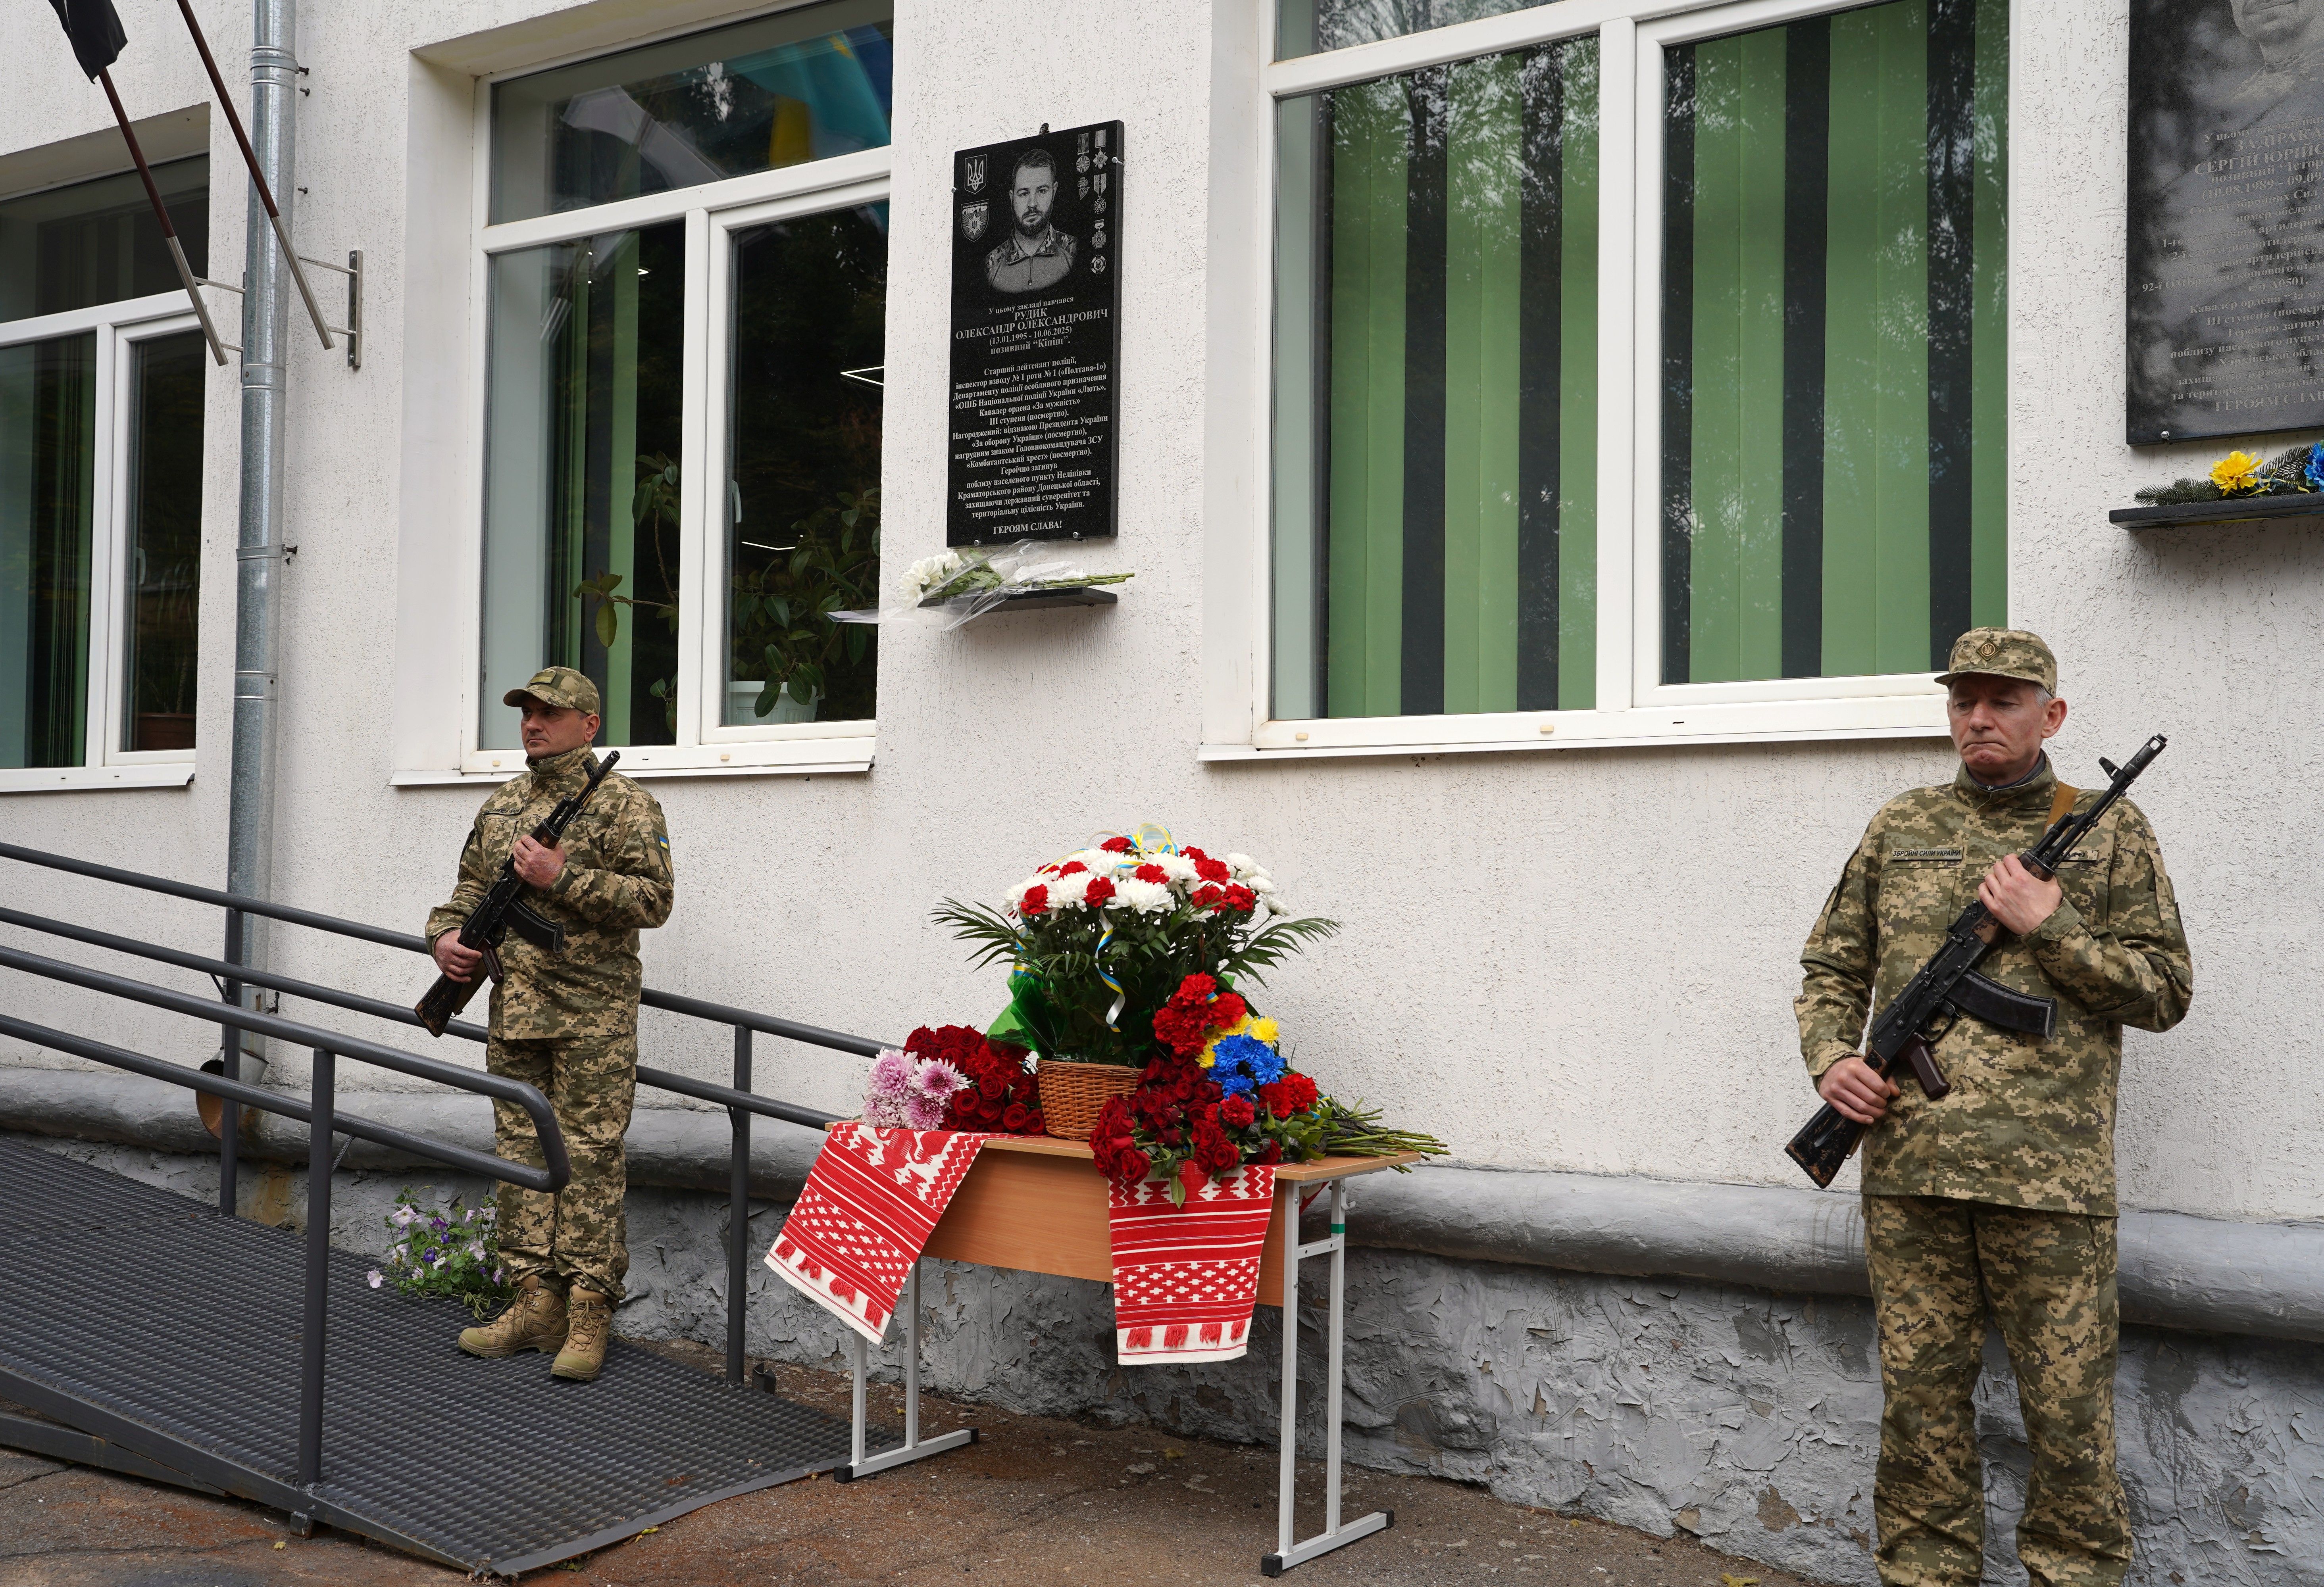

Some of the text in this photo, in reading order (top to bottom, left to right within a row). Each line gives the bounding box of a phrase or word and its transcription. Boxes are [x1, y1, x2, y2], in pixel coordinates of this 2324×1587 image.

[2204, 133, 2212, 142] У
[2216, 129, 2249, 141] цьому
[2194, 152, 2258, 175] СЕРГІЙ
[2210, 165, 2274, 184] позивний
[2202, 179, 2274, 201] (10.08.1989
[2293, 188, 2317, 199] Сил
[2237, 211, 2271, 222] номер
[2162, 238, 2183, 247] 1-го
[2172, 250, 2185, 260] 2-ї
[2142, 281, 2162, 292] 92-ї
[2237, 265, 2293, 279] кошового
[1017, 300, 1041, 310] закладі
[1043, 297, 1074, 306] навчався
[2190, 301, 2237, 313] Кавалер
[2241, 296, 2280, 307] ордена
[1014, 307, 1047, 321] РУДИК
[2224, 312, 2269, 323] ступеня
[956, 308, 1107, 340] ОЛЕКСАНДР ОЛЕКСАНДРОВИЧ
[2228, 319, 2323, 337] Героїчно загину
[989, 332, 1027, 346] (13.01.1995
[1034, 326, 1072, 338] 10.06.2025)
[991, 335, 1070, 355] позивний “Кіпіш”.
[2170, 347, 2214, 358] поблизу
[2218, 339, 2281, 352] населеного
[984, 356, 1077, 376] Старший лейтенант поліції,
[2218, 351, 2288, 367] Харківської
[956, 380, 987, 390] інспектор
[1026, 373, 1042, 382] роти
[1058, 362, 1106, 377] («Полтава-1»)
[2176, 372, 2242, 385] захищаючи
[2246, 363, 2310, 378] державний
[952, 374, 1106, 402] Департаменту поліції особливого призначення
[955, 400, 977, 409] «ОШБ
[978, 394, 1023, 407] Національної
[1024, 391, 1047, 401] поліції
[1048, 388, 1076, 398] України
[979, 408, 1007, 417] Кавалер
[1008, 405, 1031, 414] ордена
[1045, 398, 1080, 409] мужність»
[2216, 396, 2279, 411] ГЕРОЯМ
[1000, 415, 1025, 425] ступеня
[1027, 409, 1069, 422] (посмертно).
[952, 415, 1107, 440] Нагороджений: відзнакою Президента України
[984, 438, 1011, 447] оборону
[1012, 434, 1043, 444] України»
[1045, 427, 1087, 440] (посмертно),
[955, 450, 989, 461] нагрудним
[1016, 439, 1086, 453] Головнокомандувача
[1087, 435, 1103, 444] ЗСУ
[966, 447, 1092, 468] «Комбатантський хрест» (посмертно).
[966, 469, 1091, 488] поблизу населеного пункту Неліпівки
[1000, 463, 1058, 476] Героїчно загинув
[958, 477, 1100, 501] Краматорського району Донецької області,
[965, 500, 1002, 509] захищаючи
[1003, 494, 1041, 506] державний
[1042, 490, 1081, 502] суверенітет
[972, 501, 1085, 519] територіальну цілісність України.
[993, 520, 1062, 534] ГЕРОЯМ СЛАВА!
